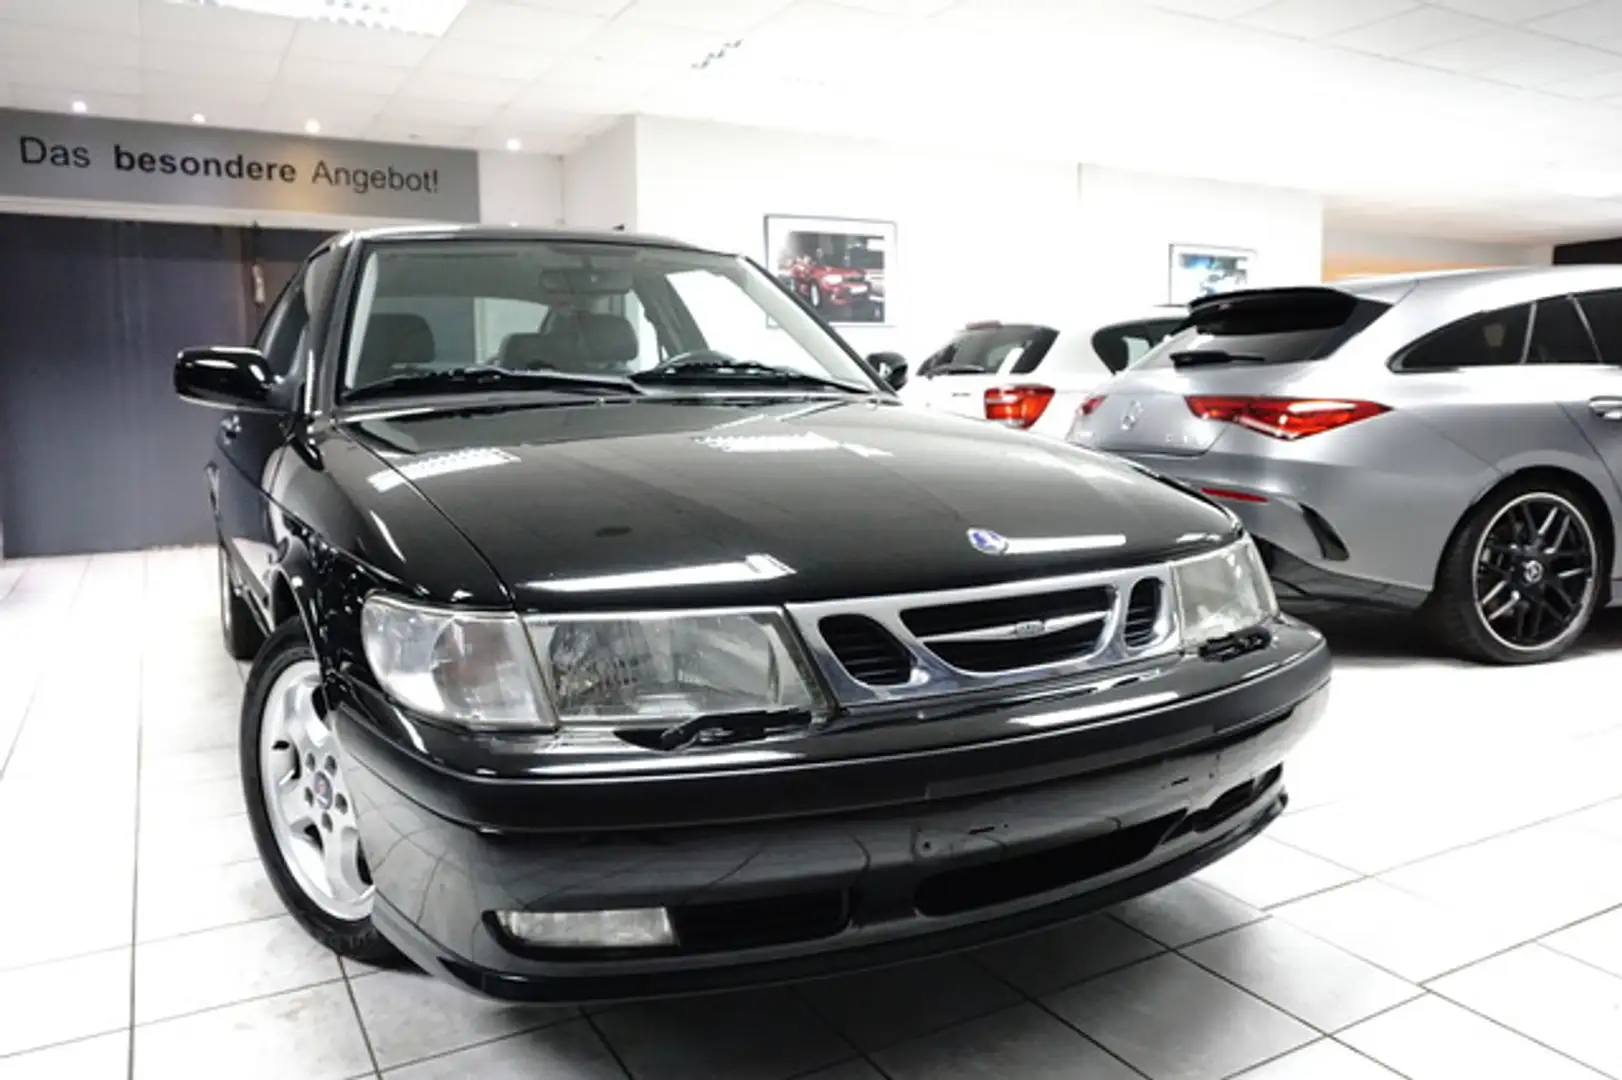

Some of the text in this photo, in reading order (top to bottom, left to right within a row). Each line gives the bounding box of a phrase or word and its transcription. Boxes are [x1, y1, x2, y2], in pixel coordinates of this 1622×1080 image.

[20, 136, 439, 193] Das besondere Angebot!
